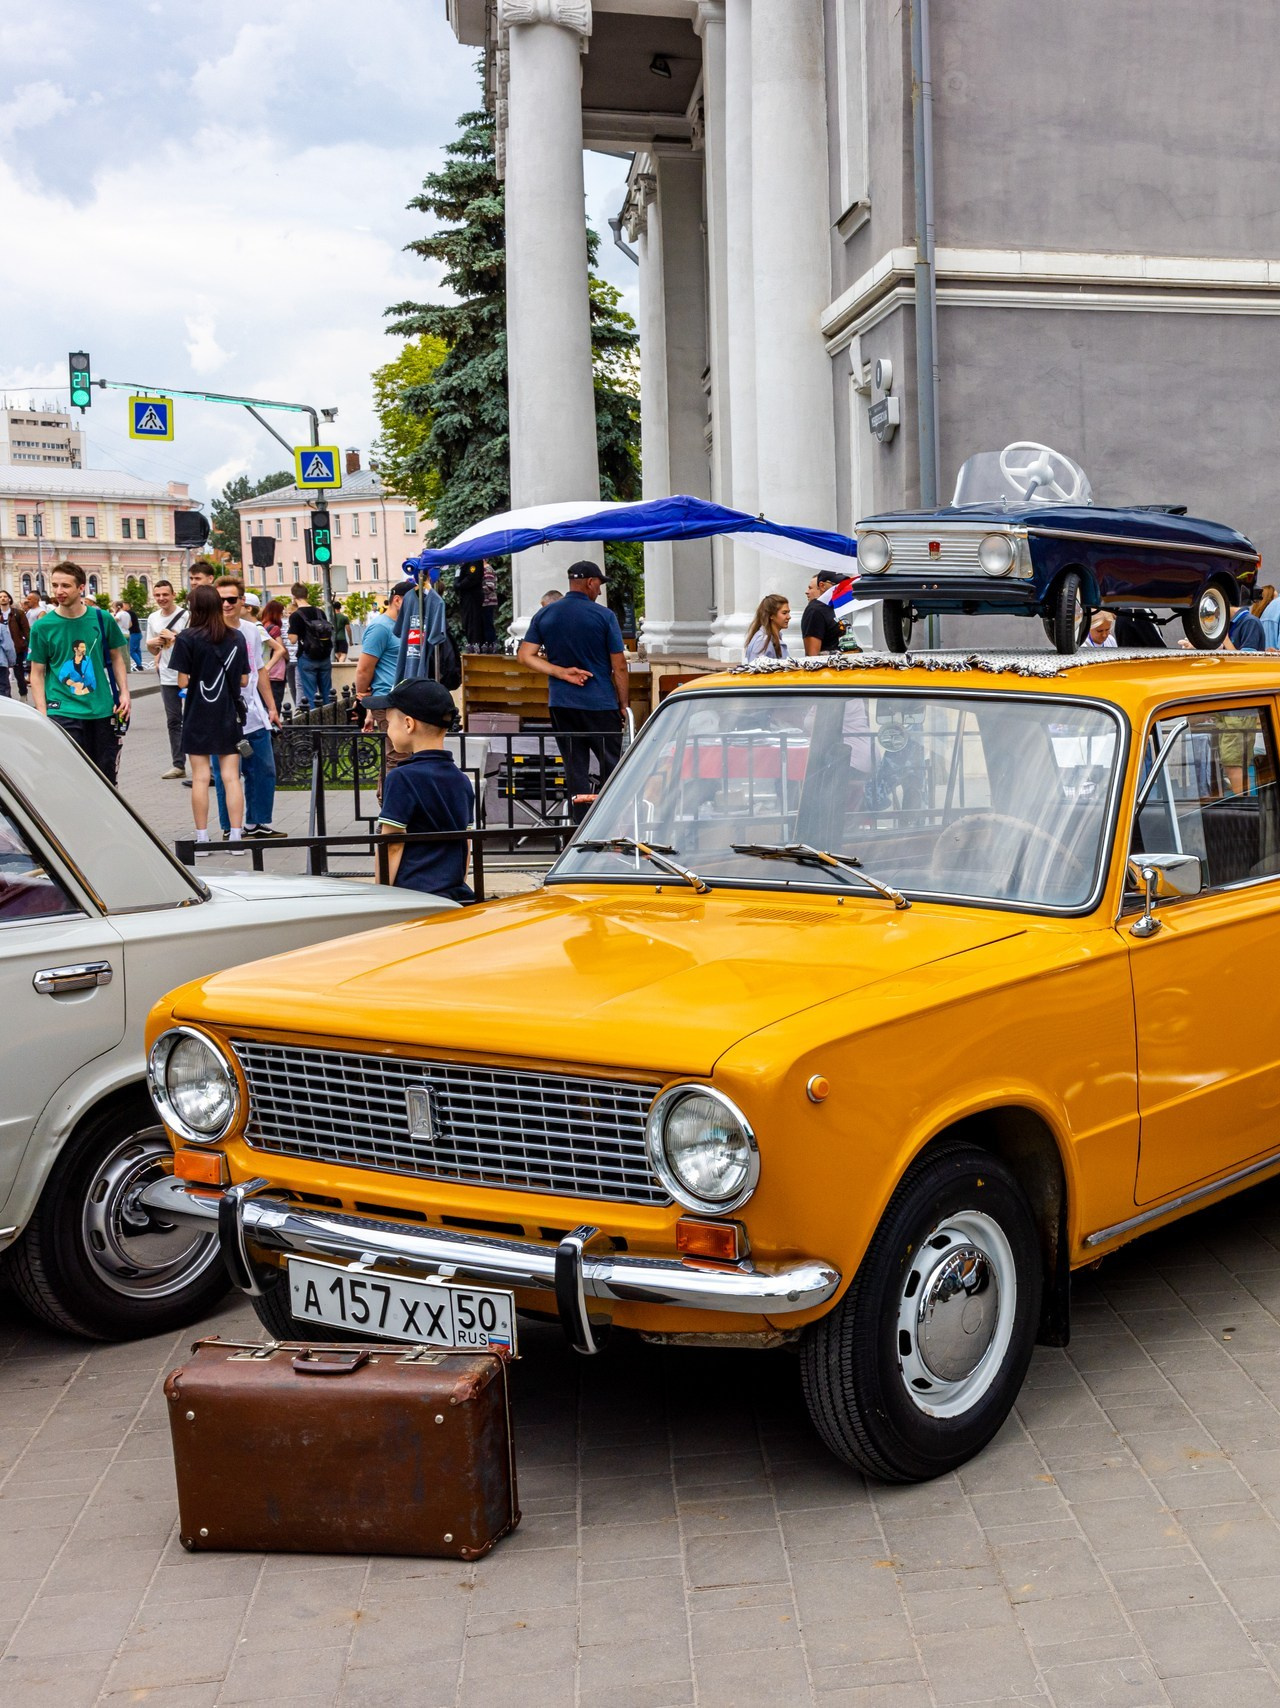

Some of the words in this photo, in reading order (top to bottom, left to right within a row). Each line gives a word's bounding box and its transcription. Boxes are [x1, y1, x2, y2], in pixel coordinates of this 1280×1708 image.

[73, 372, 89, 388] 27
[315, 529, 330, 545] 27
[457, 1294, 497, 1332] 50
[458, 1330, 488, 1346] RUS
